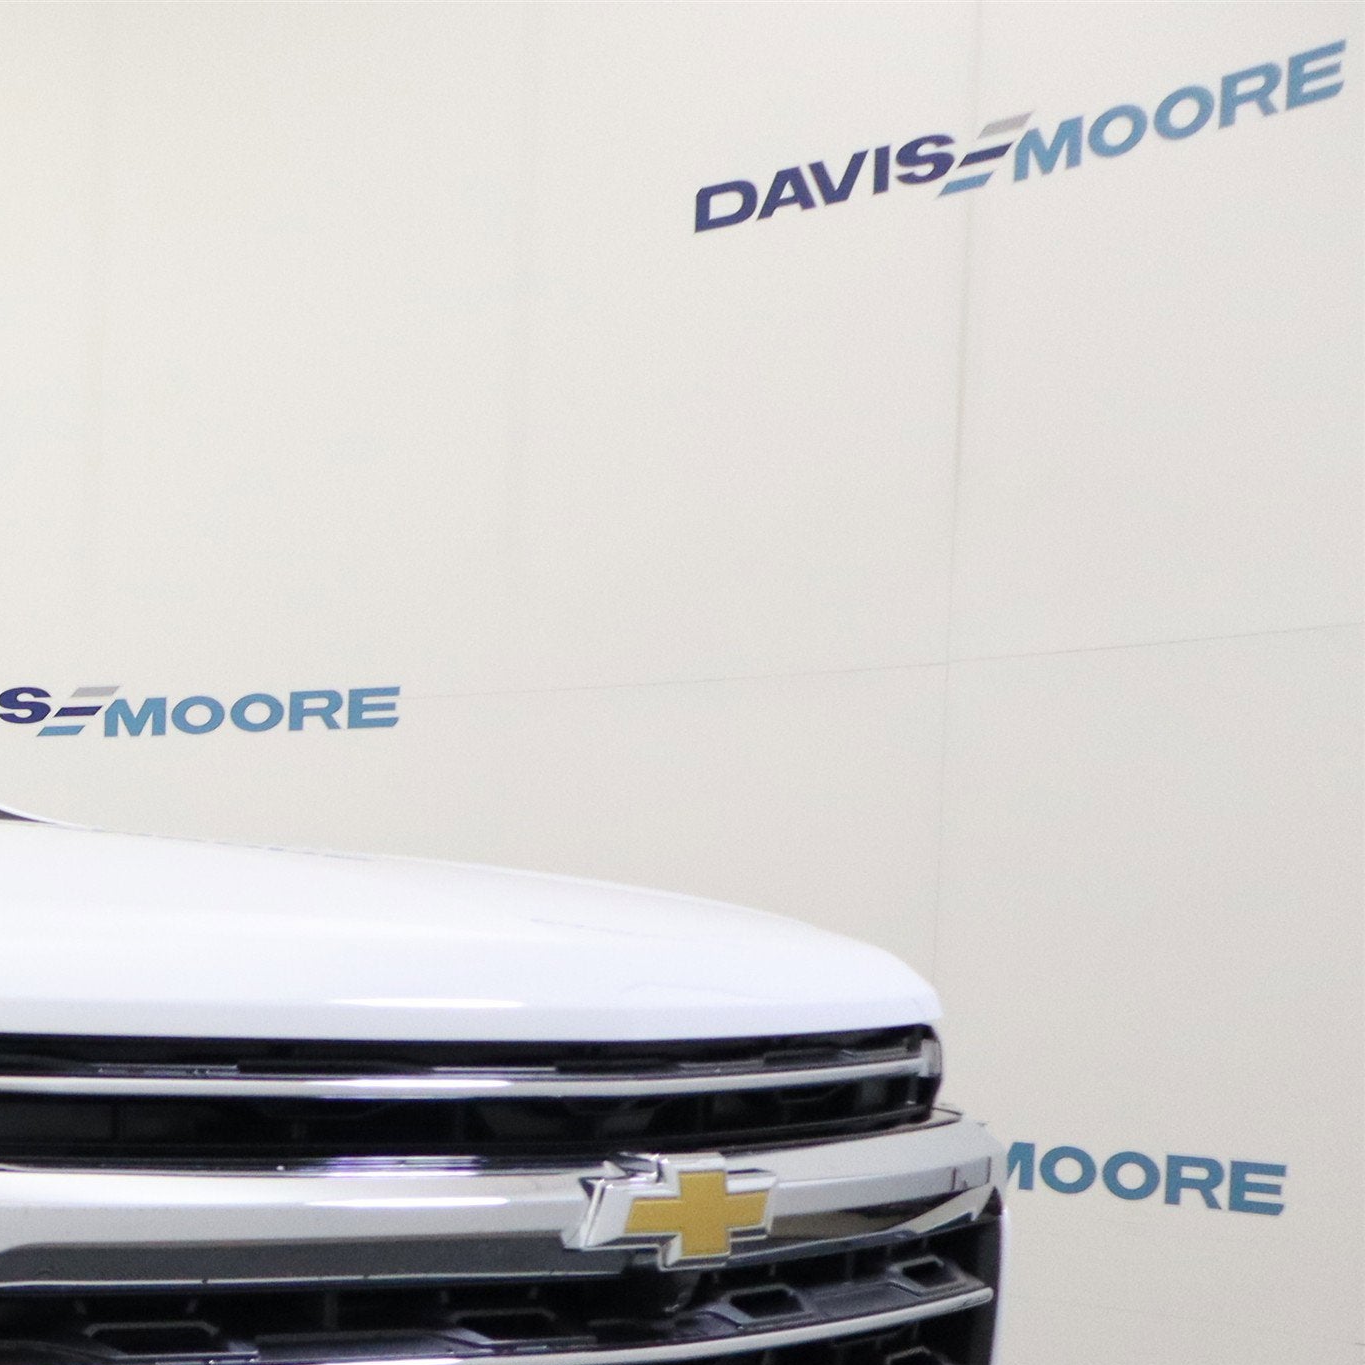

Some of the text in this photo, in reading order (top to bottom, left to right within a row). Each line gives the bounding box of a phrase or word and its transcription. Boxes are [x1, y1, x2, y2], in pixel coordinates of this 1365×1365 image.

[695, 40, 1346, 232] DAVIS MOORE
[103, 686, 401, 737] MOORE
